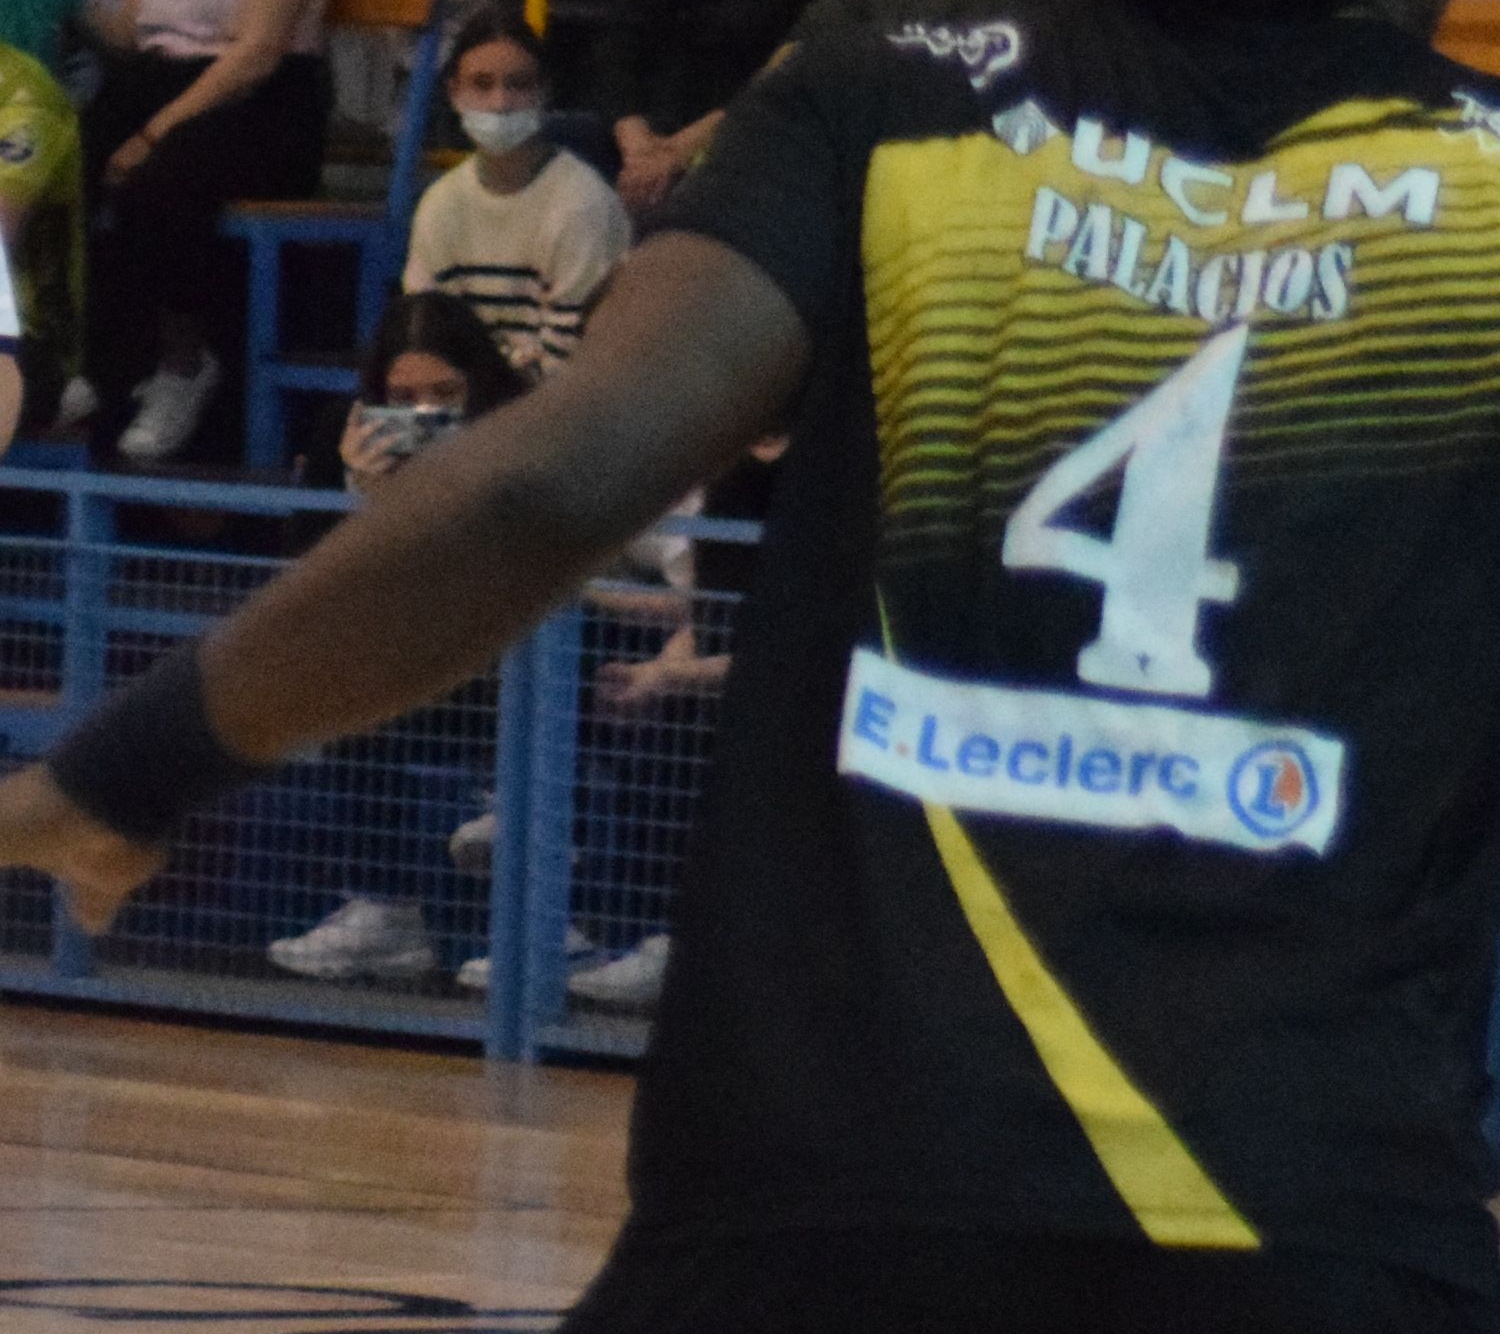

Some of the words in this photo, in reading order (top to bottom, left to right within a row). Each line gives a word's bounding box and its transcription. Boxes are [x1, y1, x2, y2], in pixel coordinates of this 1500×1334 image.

[1071, 116, 1440, 227] UCLM
[1027, 186, 1355, 323] PALACIOS
[1001, 322, 1251, 697] 4
[853, 685, 1200, 801] E.Leclerc
